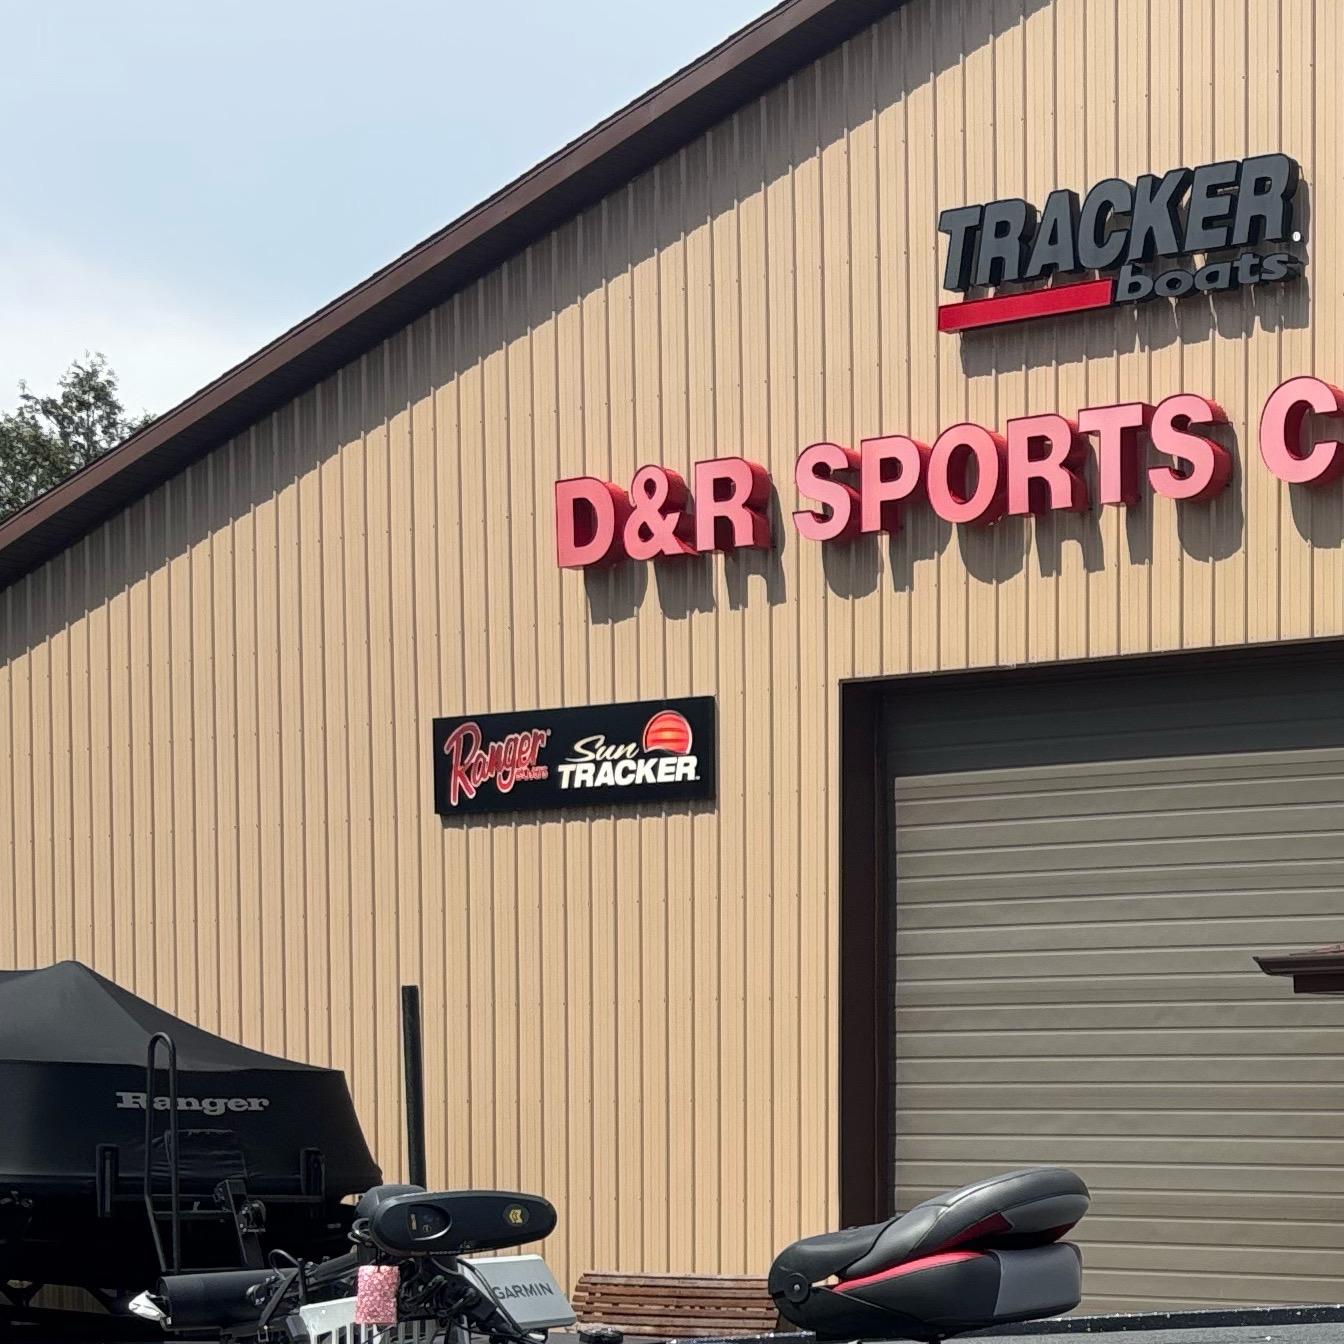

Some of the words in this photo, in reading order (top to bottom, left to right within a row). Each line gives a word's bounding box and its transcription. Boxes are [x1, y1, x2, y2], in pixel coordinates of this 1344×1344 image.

[938, 153, 1298, 292] TRACKER
[1115, 252, 1297, 303] boats
[555, 456, 771, 568] D&R
[792, 394, 1230, 543] SPORTS
[444, 721, 547, 806] Ranger
[565, 734, 639, 762] Sun
[557, 755, 698, 789] TRACKER
[115, 1090, 270, 1116] Ranger
[491, 1283, 554, 1301] GARMIN
